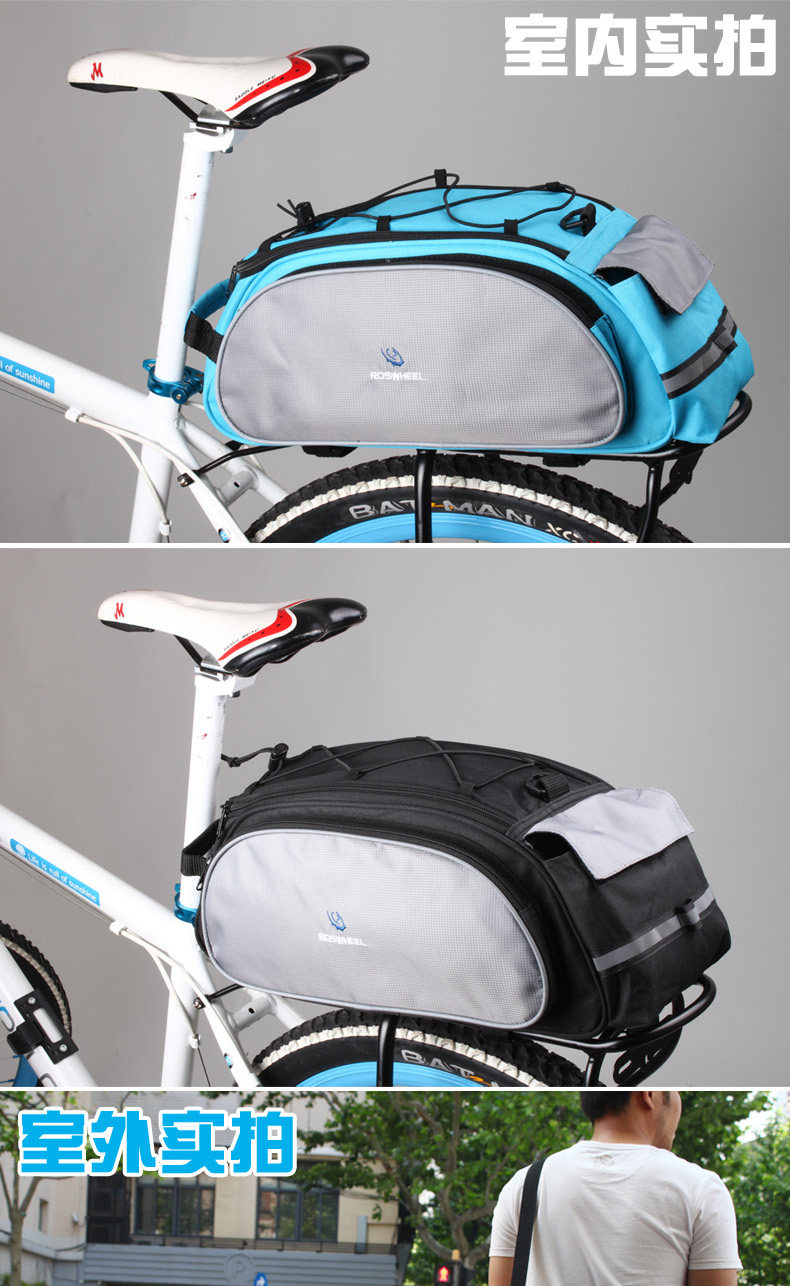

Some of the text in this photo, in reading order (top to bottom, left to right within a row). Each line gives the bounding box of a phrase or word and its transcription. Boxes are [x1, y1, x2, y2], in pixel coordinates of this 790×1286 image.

[15, 368, 51, 389] sunshine
[369, 371, 426, 381] ROSWHEEL
[318, 932, 367, 947] ROSWHEEL
